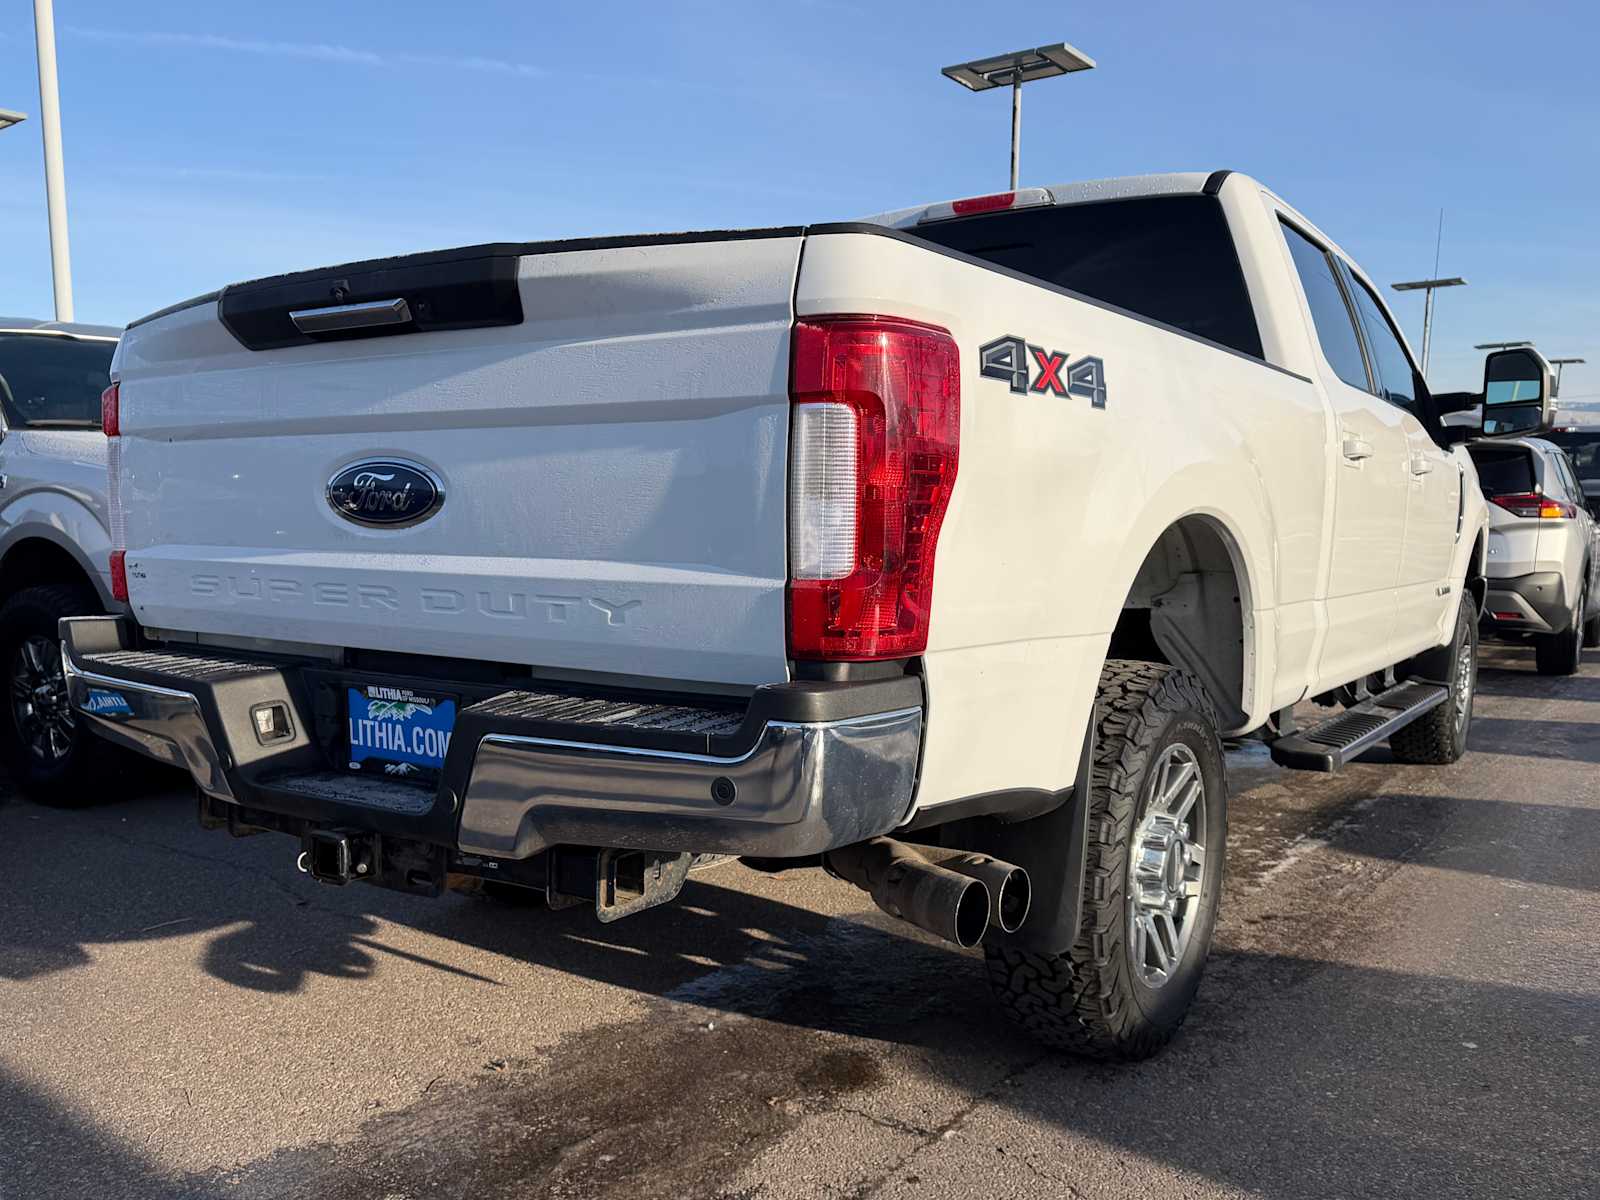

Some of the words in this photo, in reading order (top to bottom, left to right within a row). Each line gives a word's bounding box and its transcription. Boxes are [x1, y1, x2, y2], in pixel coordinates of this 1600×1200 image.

[342, 471, 411, 511] Ford
[191, 574, 400, 611] SUPER
[420, 588, 642, 626] DUTY
[375, 686, 402, 701] LITHIA
[349, 717, 452, 759] LITHIA.COM
